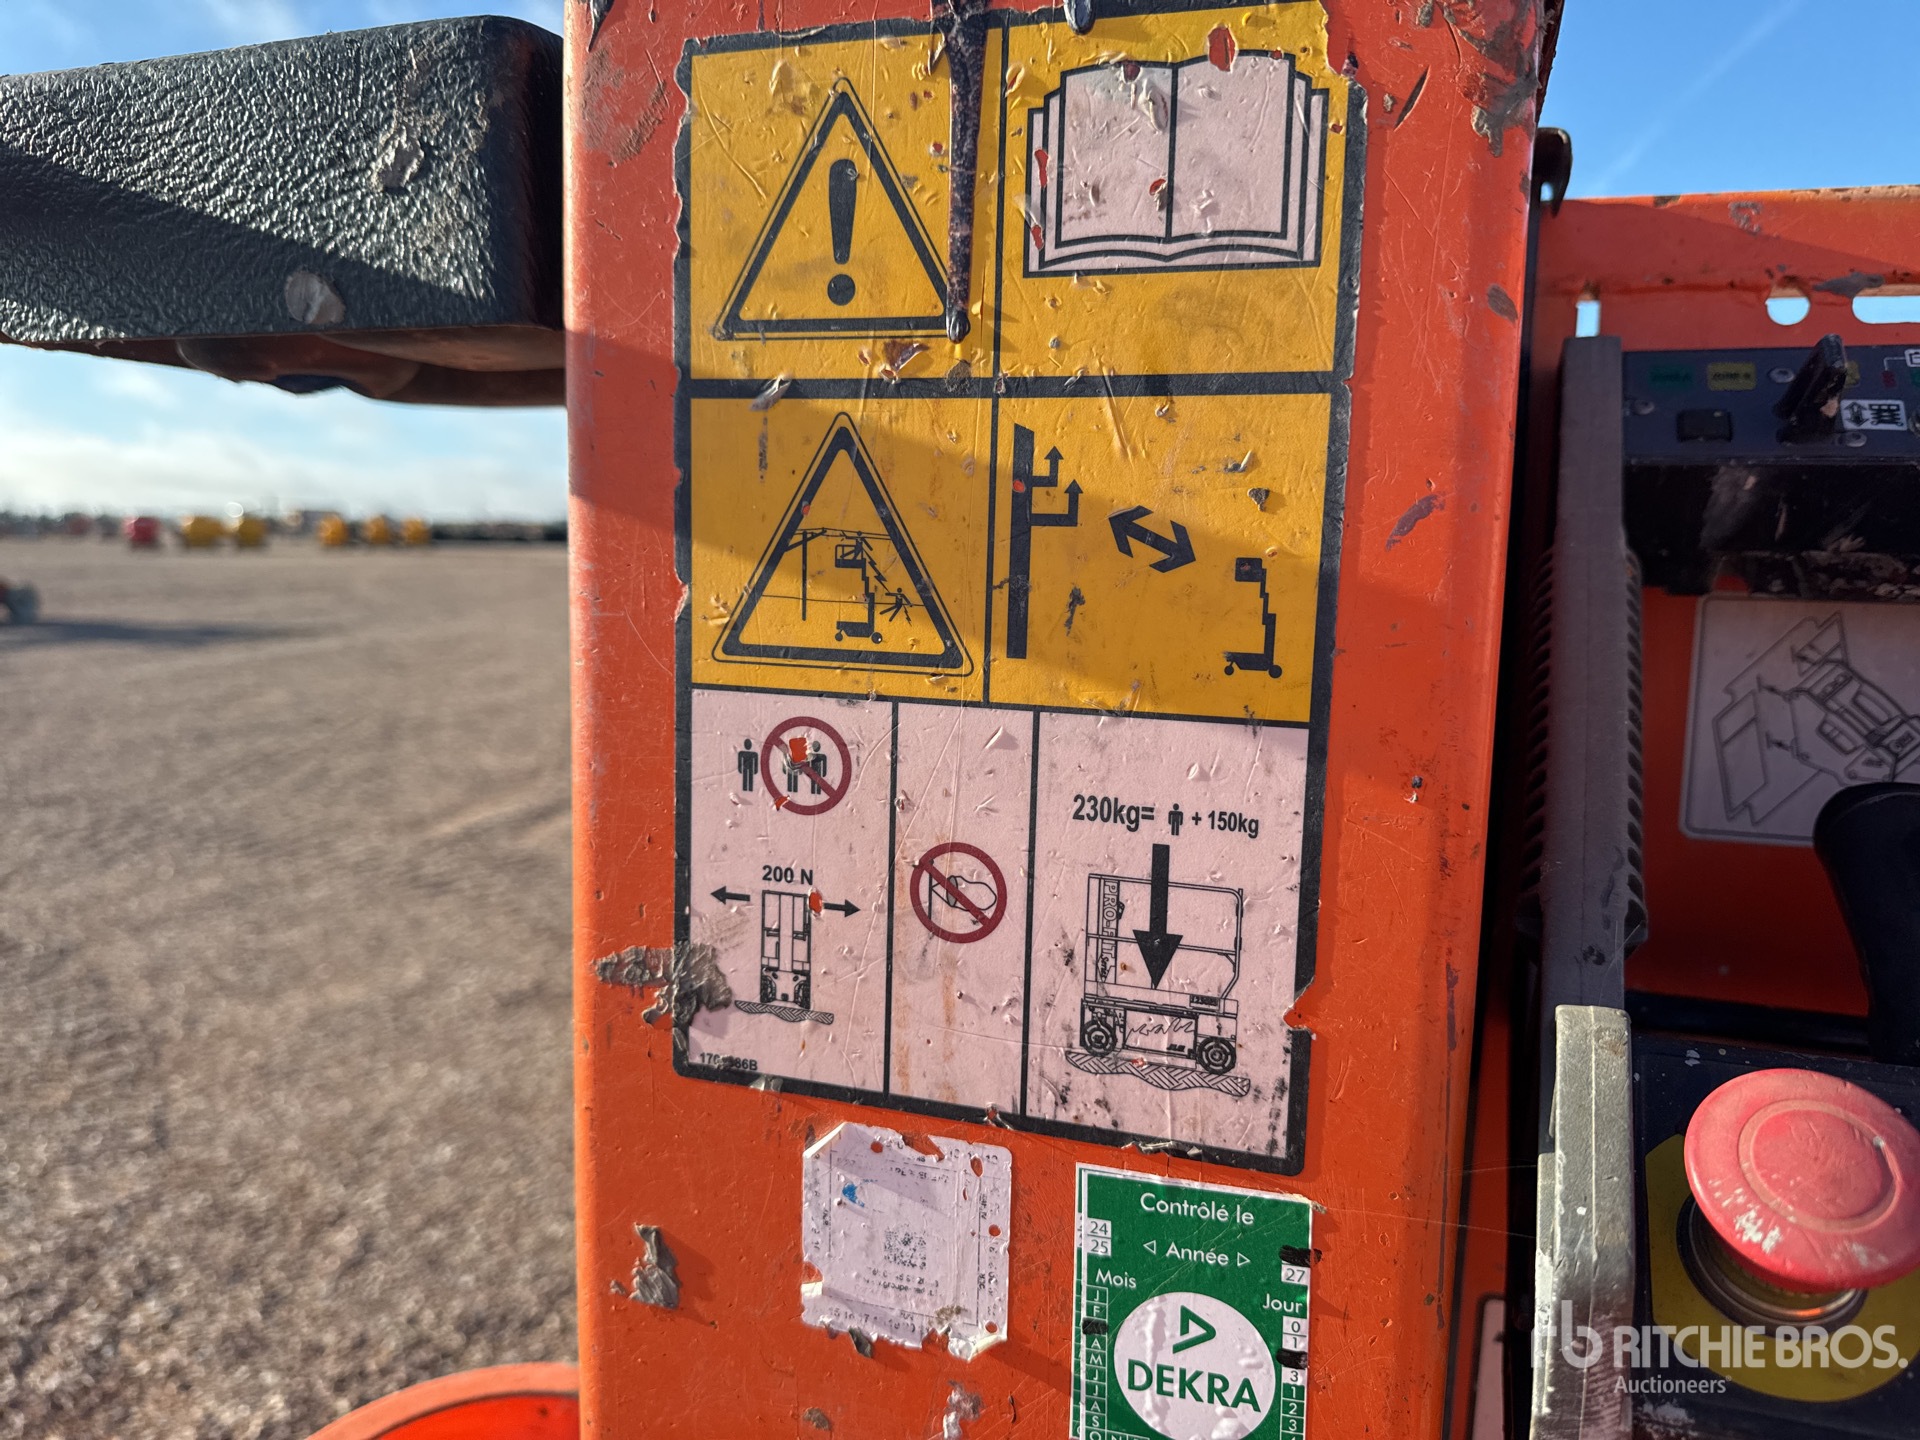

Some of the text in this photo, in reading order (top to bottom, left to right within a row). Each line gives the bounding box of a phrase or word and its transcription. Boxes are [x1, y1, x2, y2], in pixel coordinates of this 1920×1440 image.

[1072, 793, 1155, 833] 230kg=
[1207, 810, 1259, 839] 150kg
[762, 864, 813, 886] 200 N
[1140, 1192, 1254, 1225] Contrôlé le
[1090, 1220, 1108, 1236] 24
[1090, 1239, 1108, 1254] 25
[1166, 1241, 1229, 1266] Année
[1095, 1268, 1137, 1289] Mois
[1286, 1268, 1306, 1283] 27
[1093, 1289, 1100, 1302] J
[1262, 1293, 1303, 1314] Jour
[1093, 1305, 1100, 1317] F
[1291, 1321, 1300, 1333] 0
[1090, 1338, 1101, 1349] A
[1089, 1353, 1103, 1365] M
[1093, 1369, 1099, 1381] J
[1290, 1370, 1299, 1382] 3
[1093, 1385, 1099, 1396] J
[1127, 1358, 1261, 1413] DEKRA
[1291, 1386, 1296, 1398] 1
[1090, 1401, 1101, 1412] A
[1289, 1403, 1297, 1415] 2
[1092, 1416, 1100, 1427] S
[1288, 1419, 1297, 1431] 3
